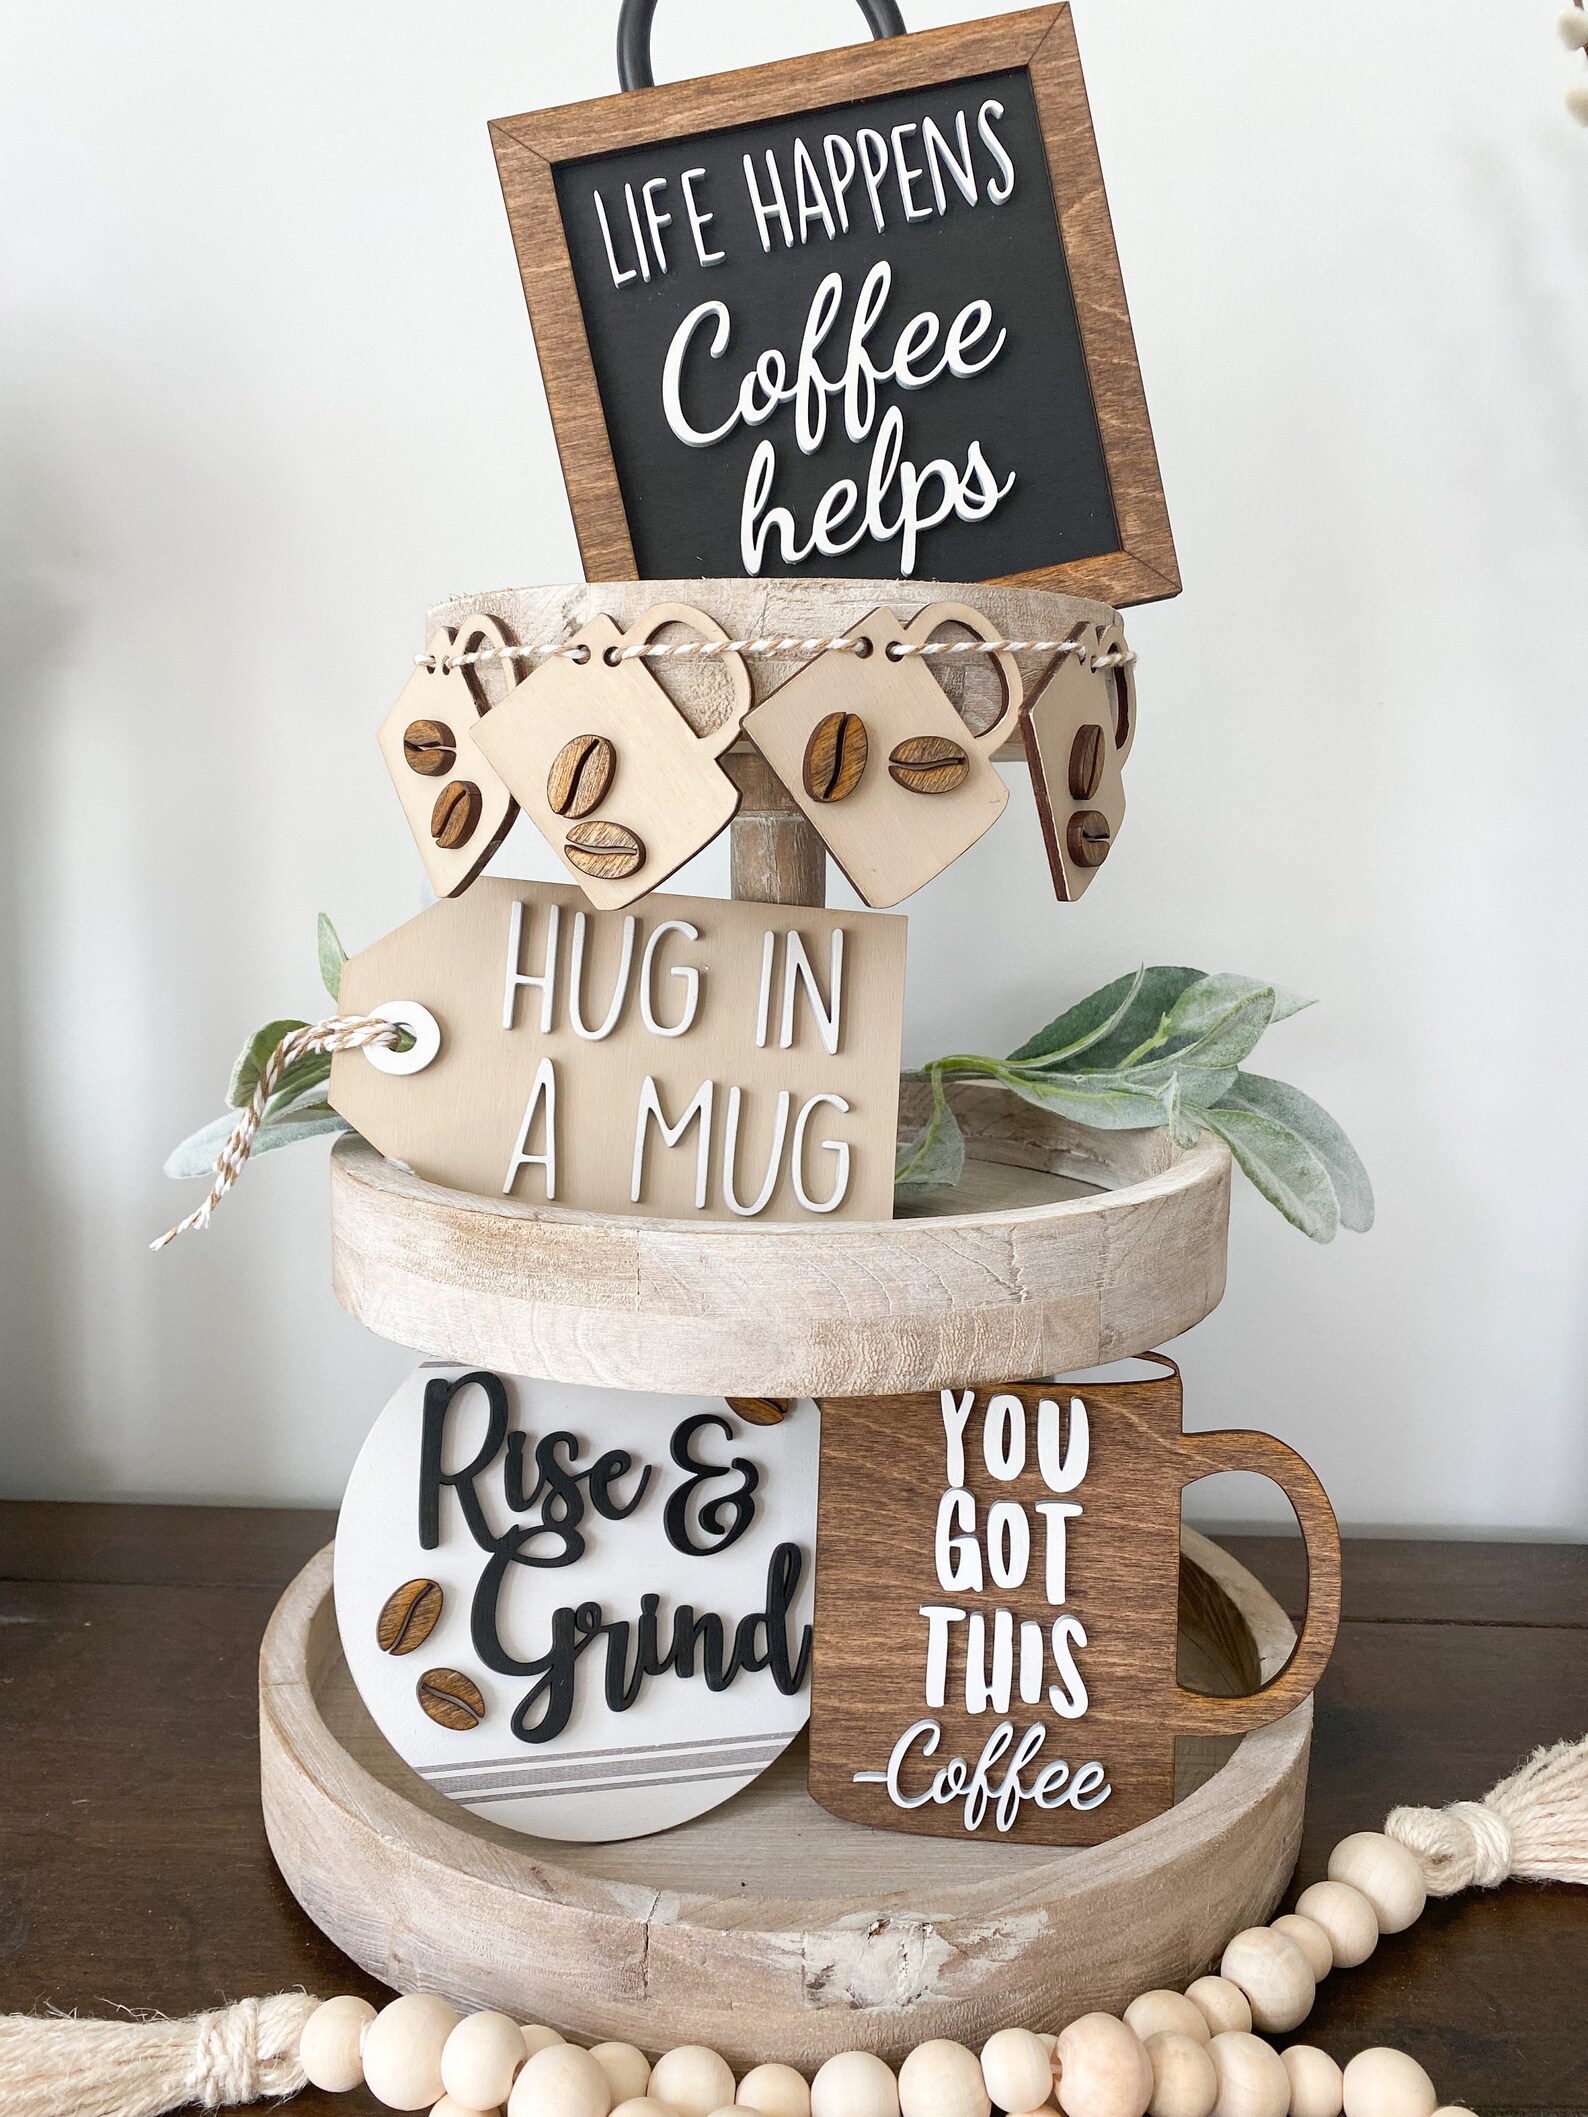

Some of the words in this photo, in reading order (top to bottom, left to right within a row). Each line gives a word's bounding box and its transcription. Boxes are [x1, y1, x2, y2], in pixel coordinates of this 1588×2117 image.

[592, 167, 727, 289] LIFE
[743, 99, 1016, 252] HAPPENS
[661, 260, 1007, 455] Coffee
[740, 405, 1016, 577] helps
[502, 901, 699, 1042] HUG
[756, 928, 845, 1055] IN
[502, 1057, 556, 1200] A
[630, 1075, 850, 1217] MUG
[418, 1371, 652, 1553] Rise
[663, 1413, 759, 1557] &
[940, 1388, 1090, 1493] YOU
[935, 1486, 1083, 1606] GOT
[470, 1524, 813, 1744] Grind
[919, 1603, 1089, 1719] THIS
